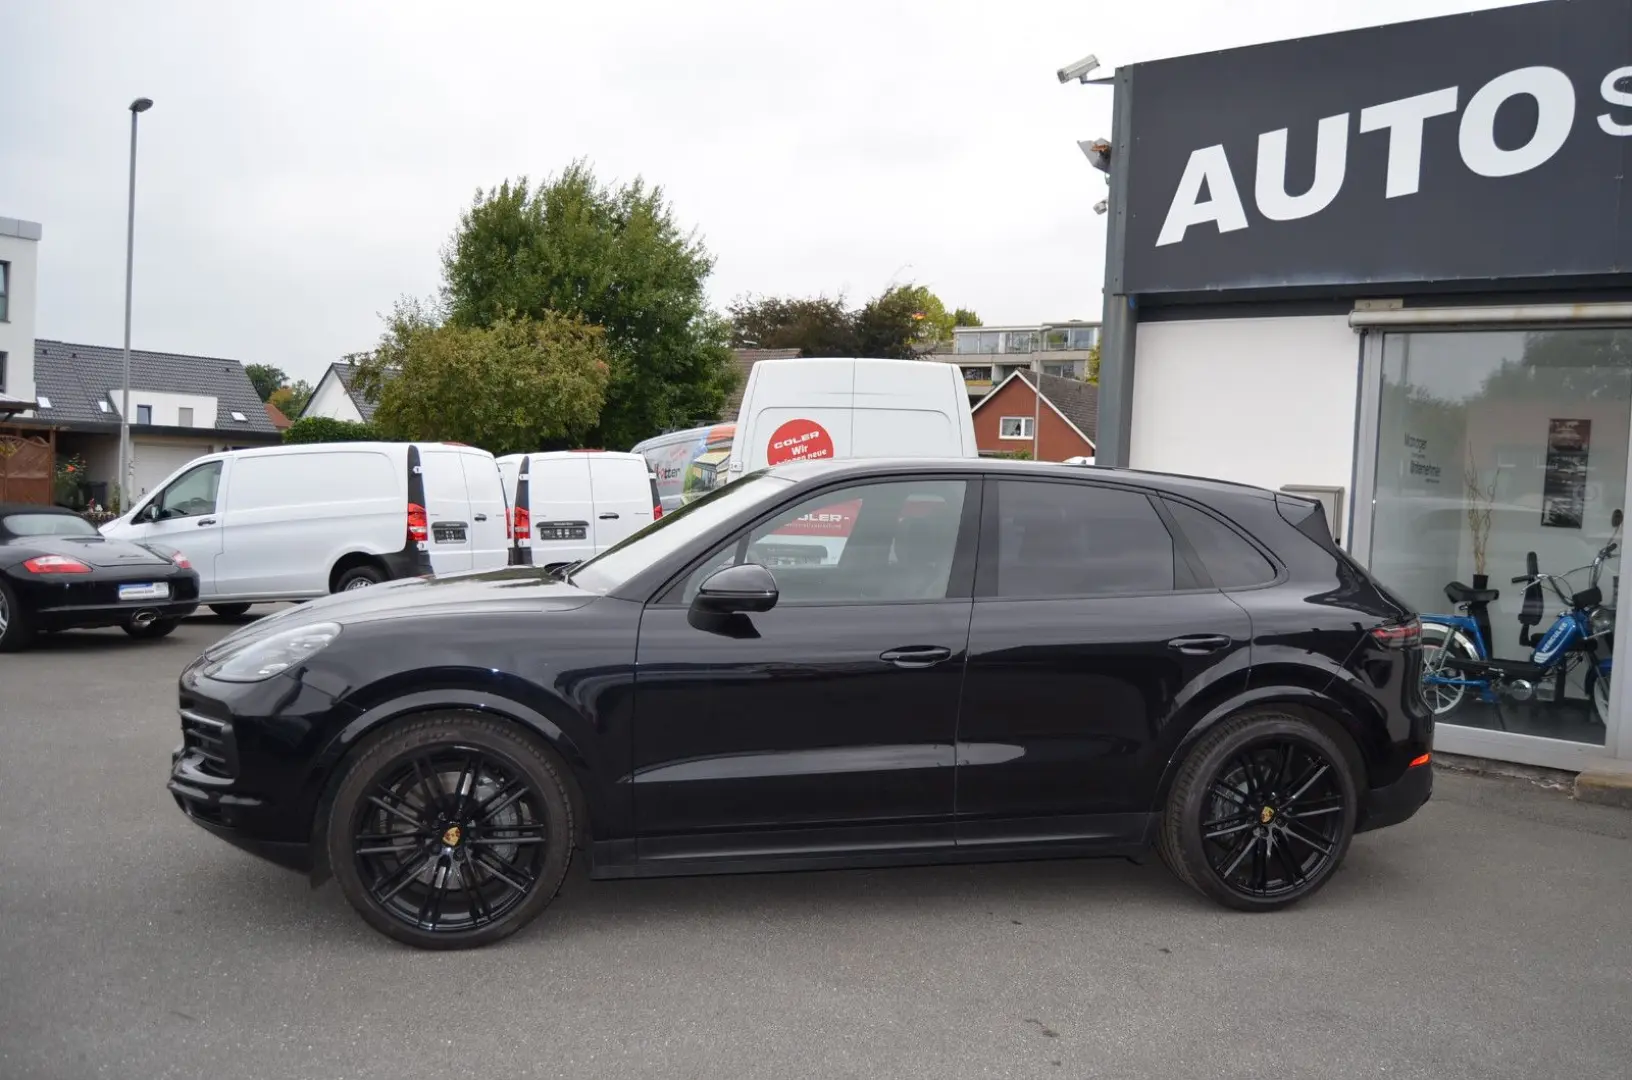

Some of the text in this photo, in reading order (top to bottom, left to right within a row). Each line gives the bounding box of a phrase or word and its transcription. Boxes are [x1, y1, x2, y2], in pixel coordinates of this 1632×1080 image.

[1155, 65, 1576, 248] AUTO
[773, 430, 820, 450] COLER
[791, 444, 809, 456] Wir
[807, 449, 827, 460] neue
[1541, 621, 1568, 653] HERCULES
